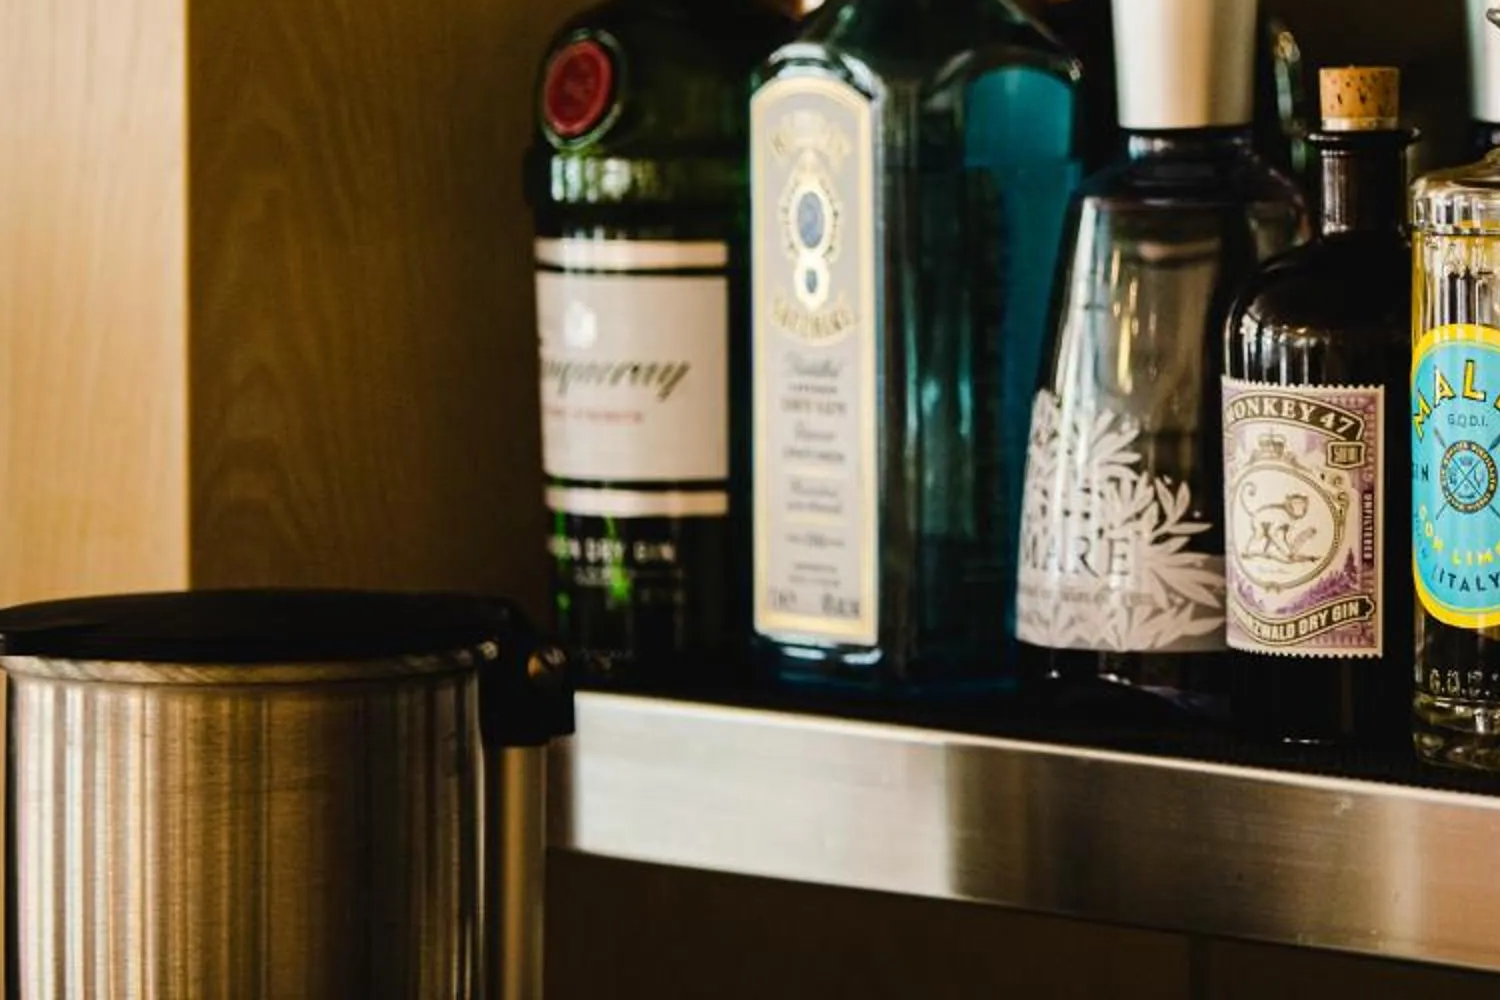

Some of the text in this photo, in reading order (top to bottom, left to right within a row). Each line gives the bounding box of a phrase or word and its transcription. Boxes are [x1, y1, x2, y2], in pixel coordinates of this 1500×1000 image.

[1319, 411, 1355, 434] 47
[1298, 610, 1329, 635] DRY
[1331, 601, 1360, 621] GIN
